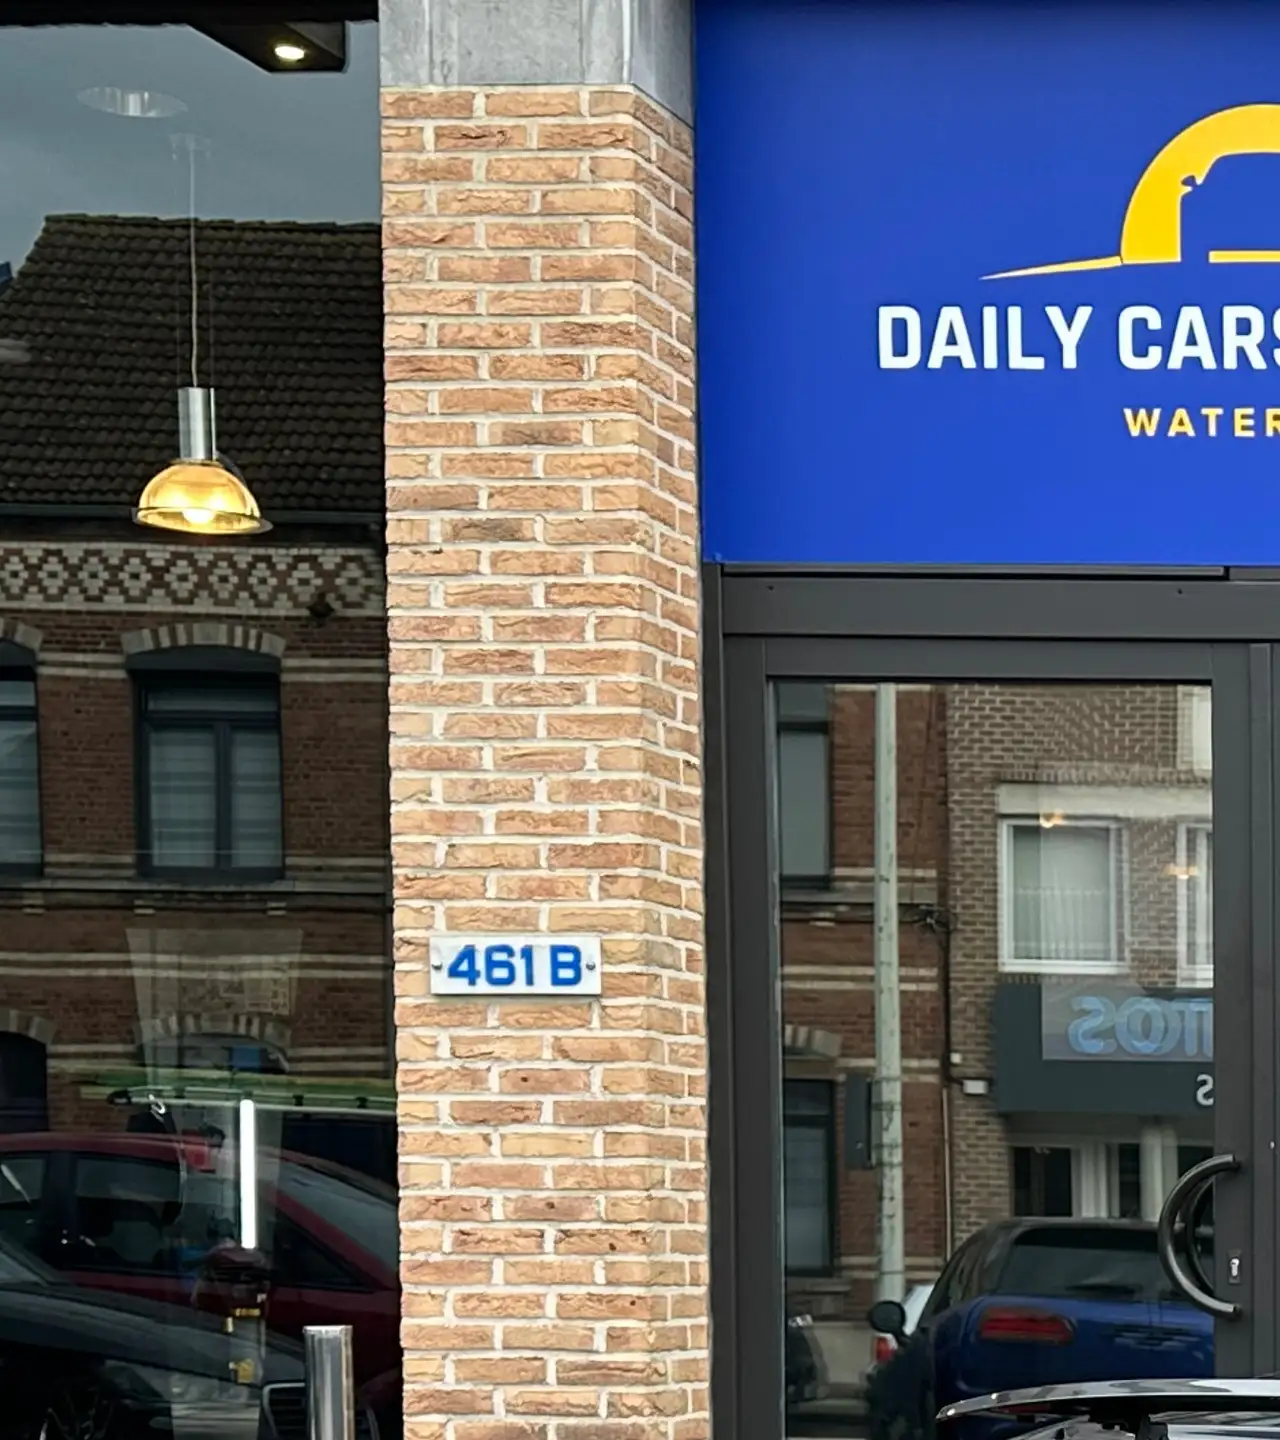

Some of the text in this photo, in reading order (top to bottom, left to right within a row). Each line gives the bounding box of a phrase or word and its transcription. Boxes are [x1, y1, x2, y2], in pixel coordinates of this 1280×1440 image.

[876, 304, 1093, 371] DAILY
[447, 943, 583, 987] 461 B
